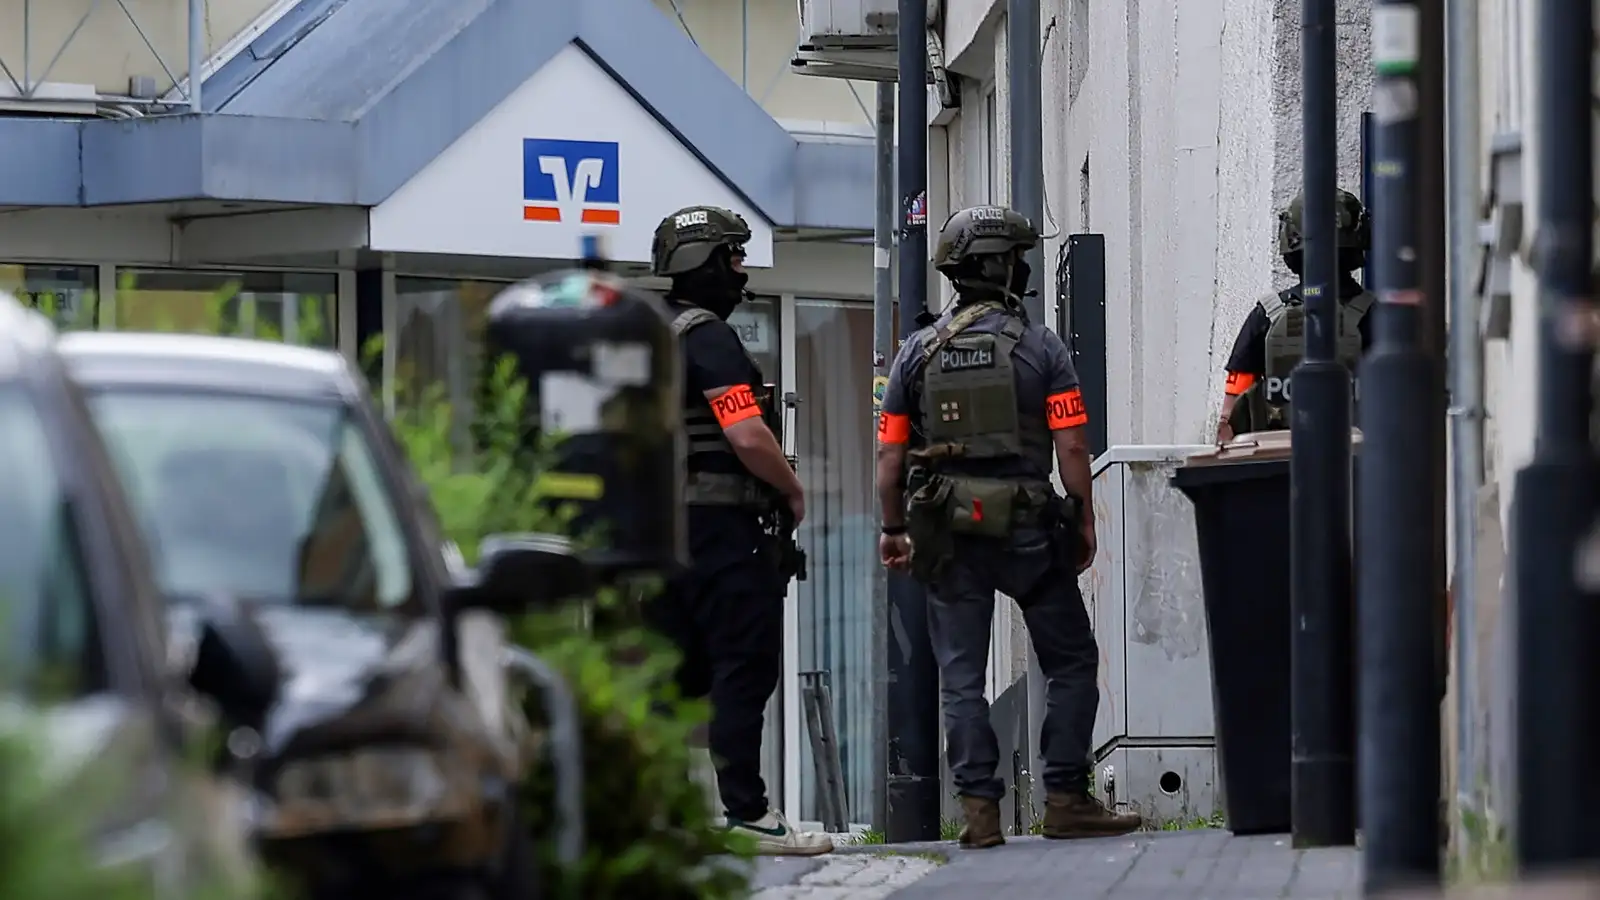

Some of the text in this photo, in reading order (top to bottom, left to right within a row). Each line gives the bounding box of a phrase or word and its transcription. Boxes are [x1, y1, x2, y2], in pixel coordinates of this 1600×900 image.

[675, 211, 708, 229] POLIZEI
[971, 208, 1004, 221] POLIZEI
[941, 349, 992, 368] POLIZEI
